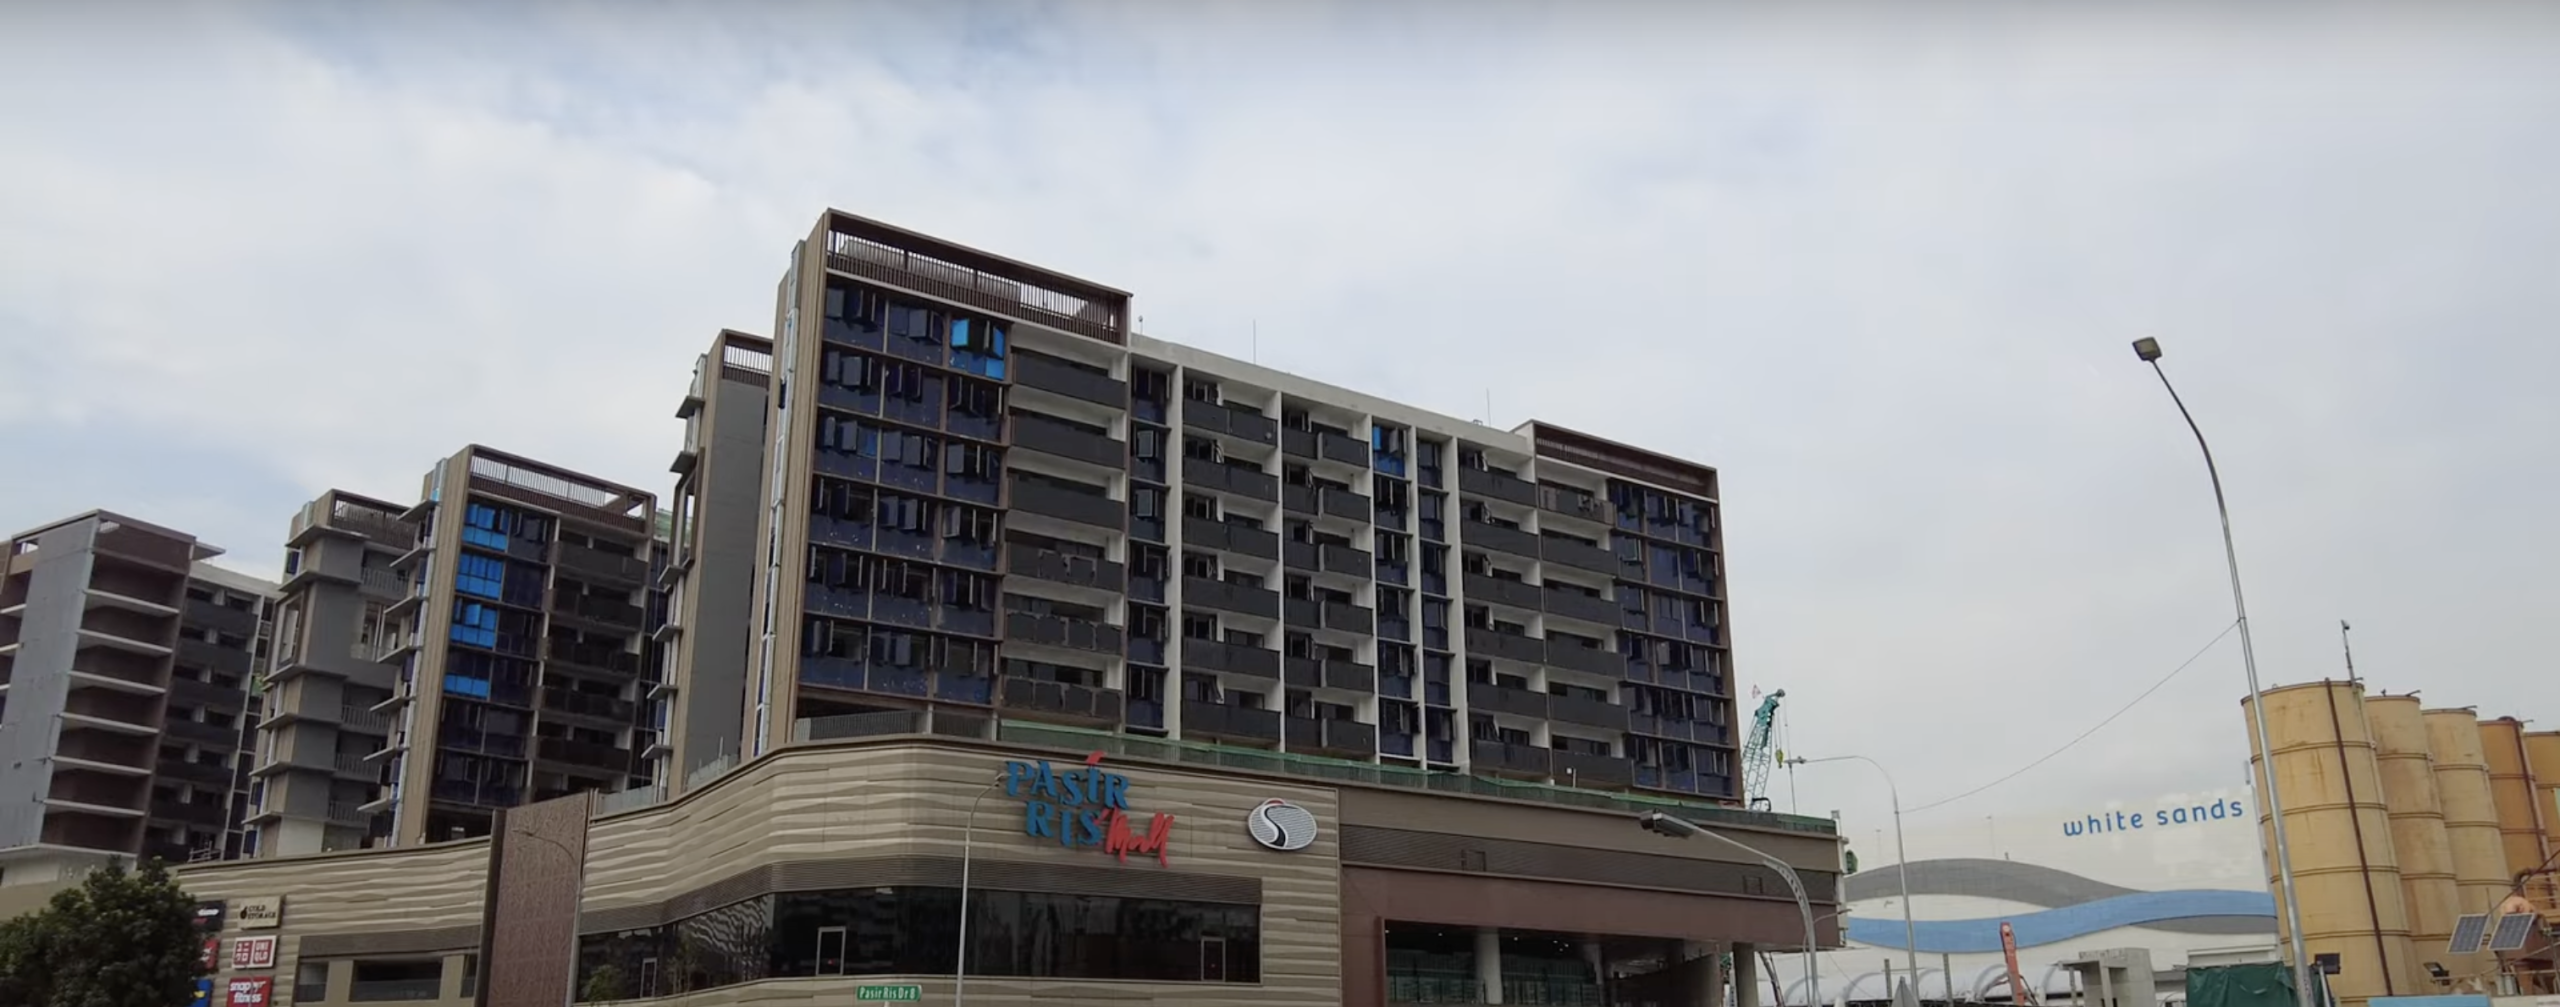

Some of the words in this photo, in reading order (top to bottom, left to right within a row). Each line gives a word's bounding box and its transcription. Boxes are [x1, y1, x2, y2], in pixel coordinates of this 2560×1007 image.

[1026, 800, 1102, 848] RIS
[2063, 811, 2144, 837] white
[2156, 798, 2243, 826] sands
[1094, 803, 1175, 868] Mall
[255, 942, 269, 951] UNI
[254, 951, 268, 962] QLO
[230, 982, 251, 993] snap
[859, 986, 882, 999] Pasir
[883, 986, 897, 999] Ris
[898, 986, 908, 999] Dr
